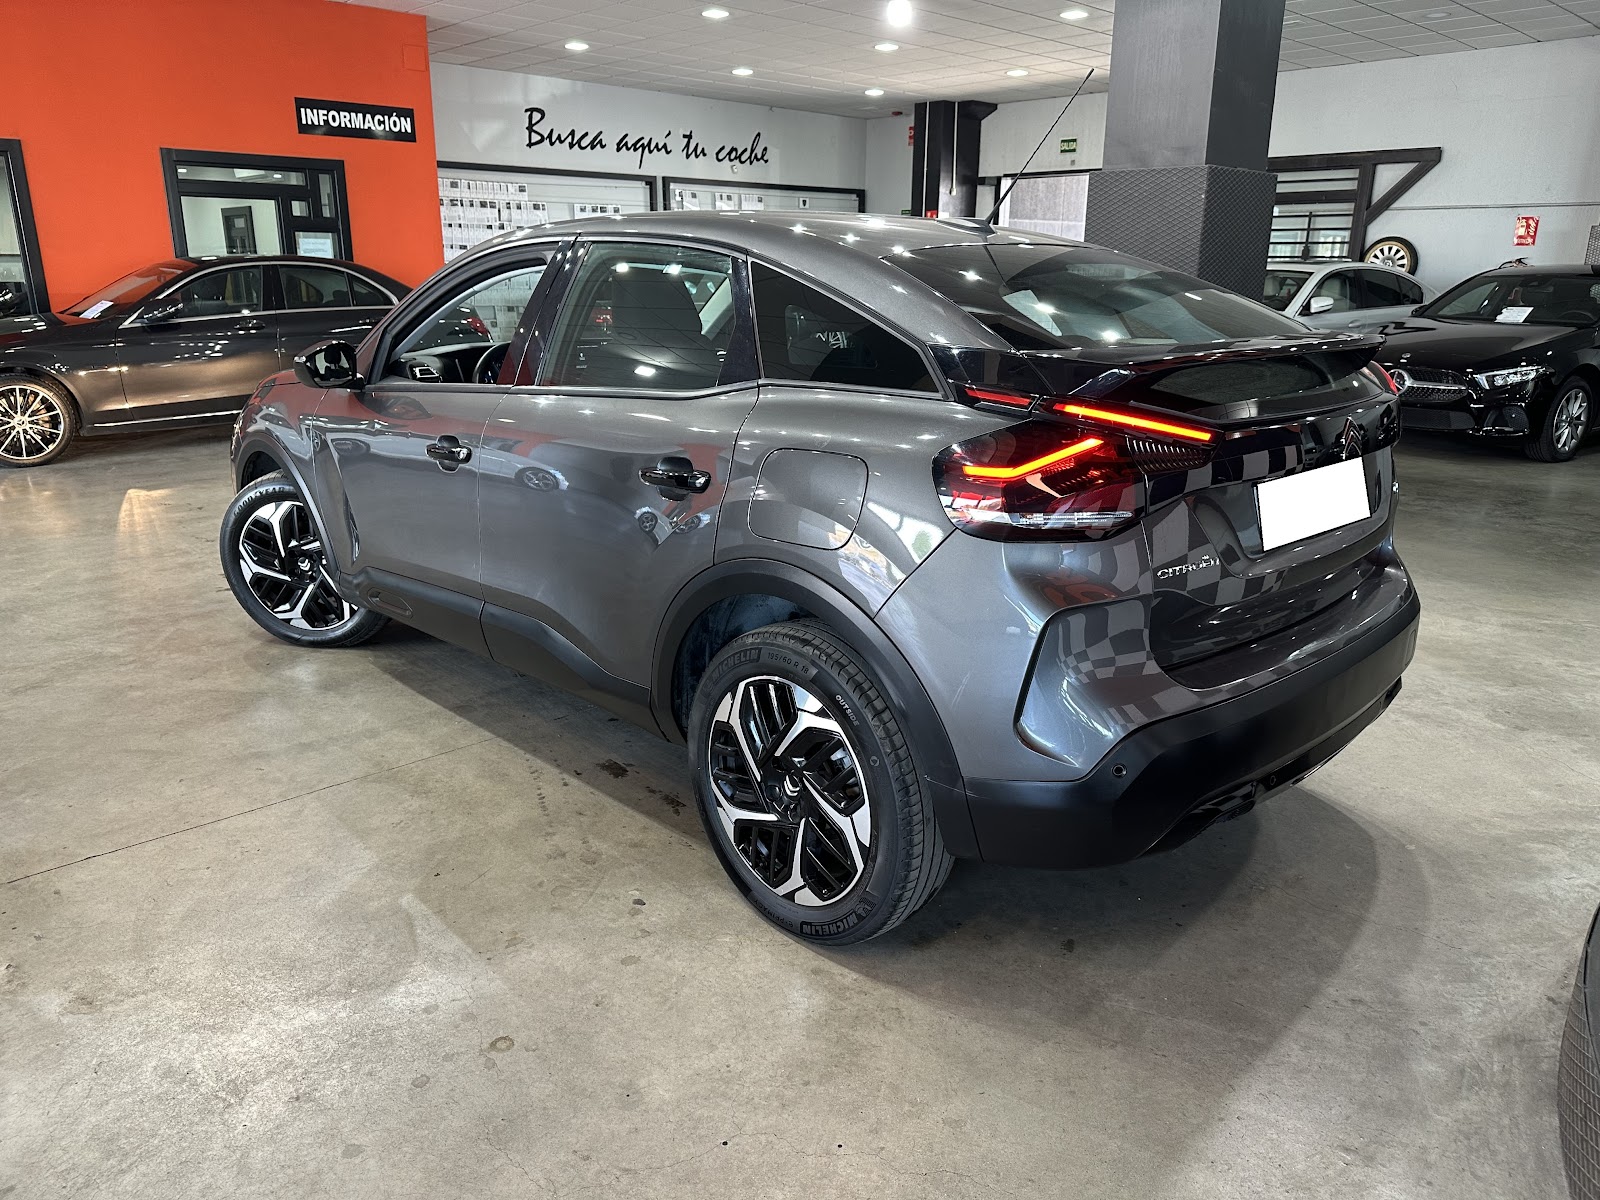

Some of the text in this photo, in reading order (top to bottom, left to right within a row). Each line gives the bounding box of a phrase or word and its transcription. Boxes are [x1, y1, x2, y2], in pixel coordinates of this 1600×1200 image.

[300, 107, 412, 133] INFORMACIÓN
[524, 106, 769, 169] Busca aquí tu coche
[712, 648, 760, 681] MICHELIN
[767, 651, 810, 675] 195/60 R 18
[835, 694, 860, 727] OUTSIDE
[802, 911, 859, 936] MICHELIN
